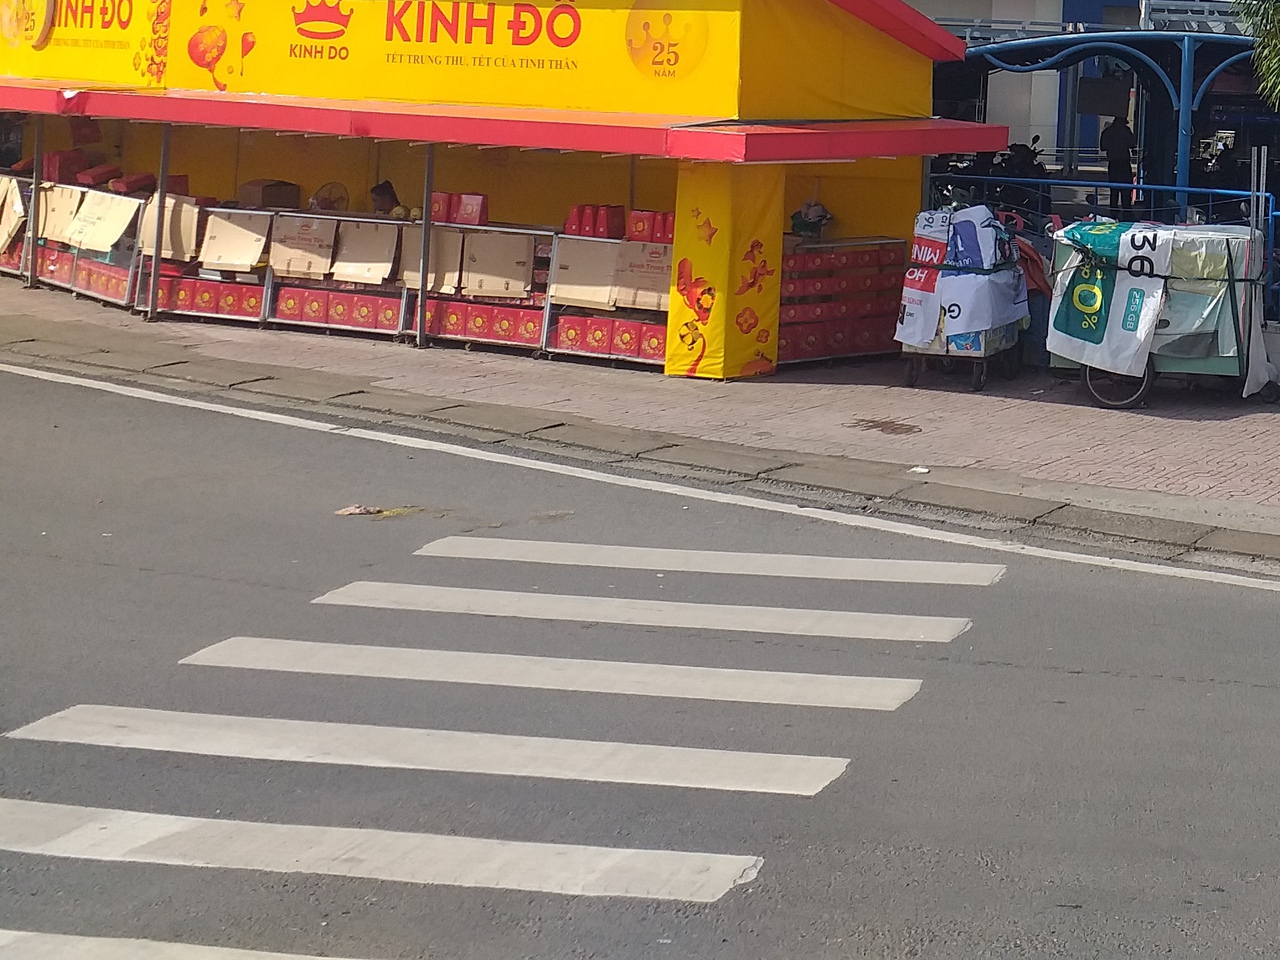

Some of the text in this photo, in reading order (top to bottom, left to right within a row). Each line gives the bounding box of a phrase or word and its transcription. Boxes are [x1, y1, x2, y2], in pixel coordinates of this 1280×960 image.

[25, 12, 35, 31] 25
[385, 0, 496, 45] KINH
[289, 44, 349, 61] KINH DO
[385, 51, 404, 64] TẾT
[407, 54, 442, 66] TRUNG
[472, 54, 492, 67] TẾT
[652, 41, 679, 66] 25
[1125, 290, 1142, 329] 256 GB
